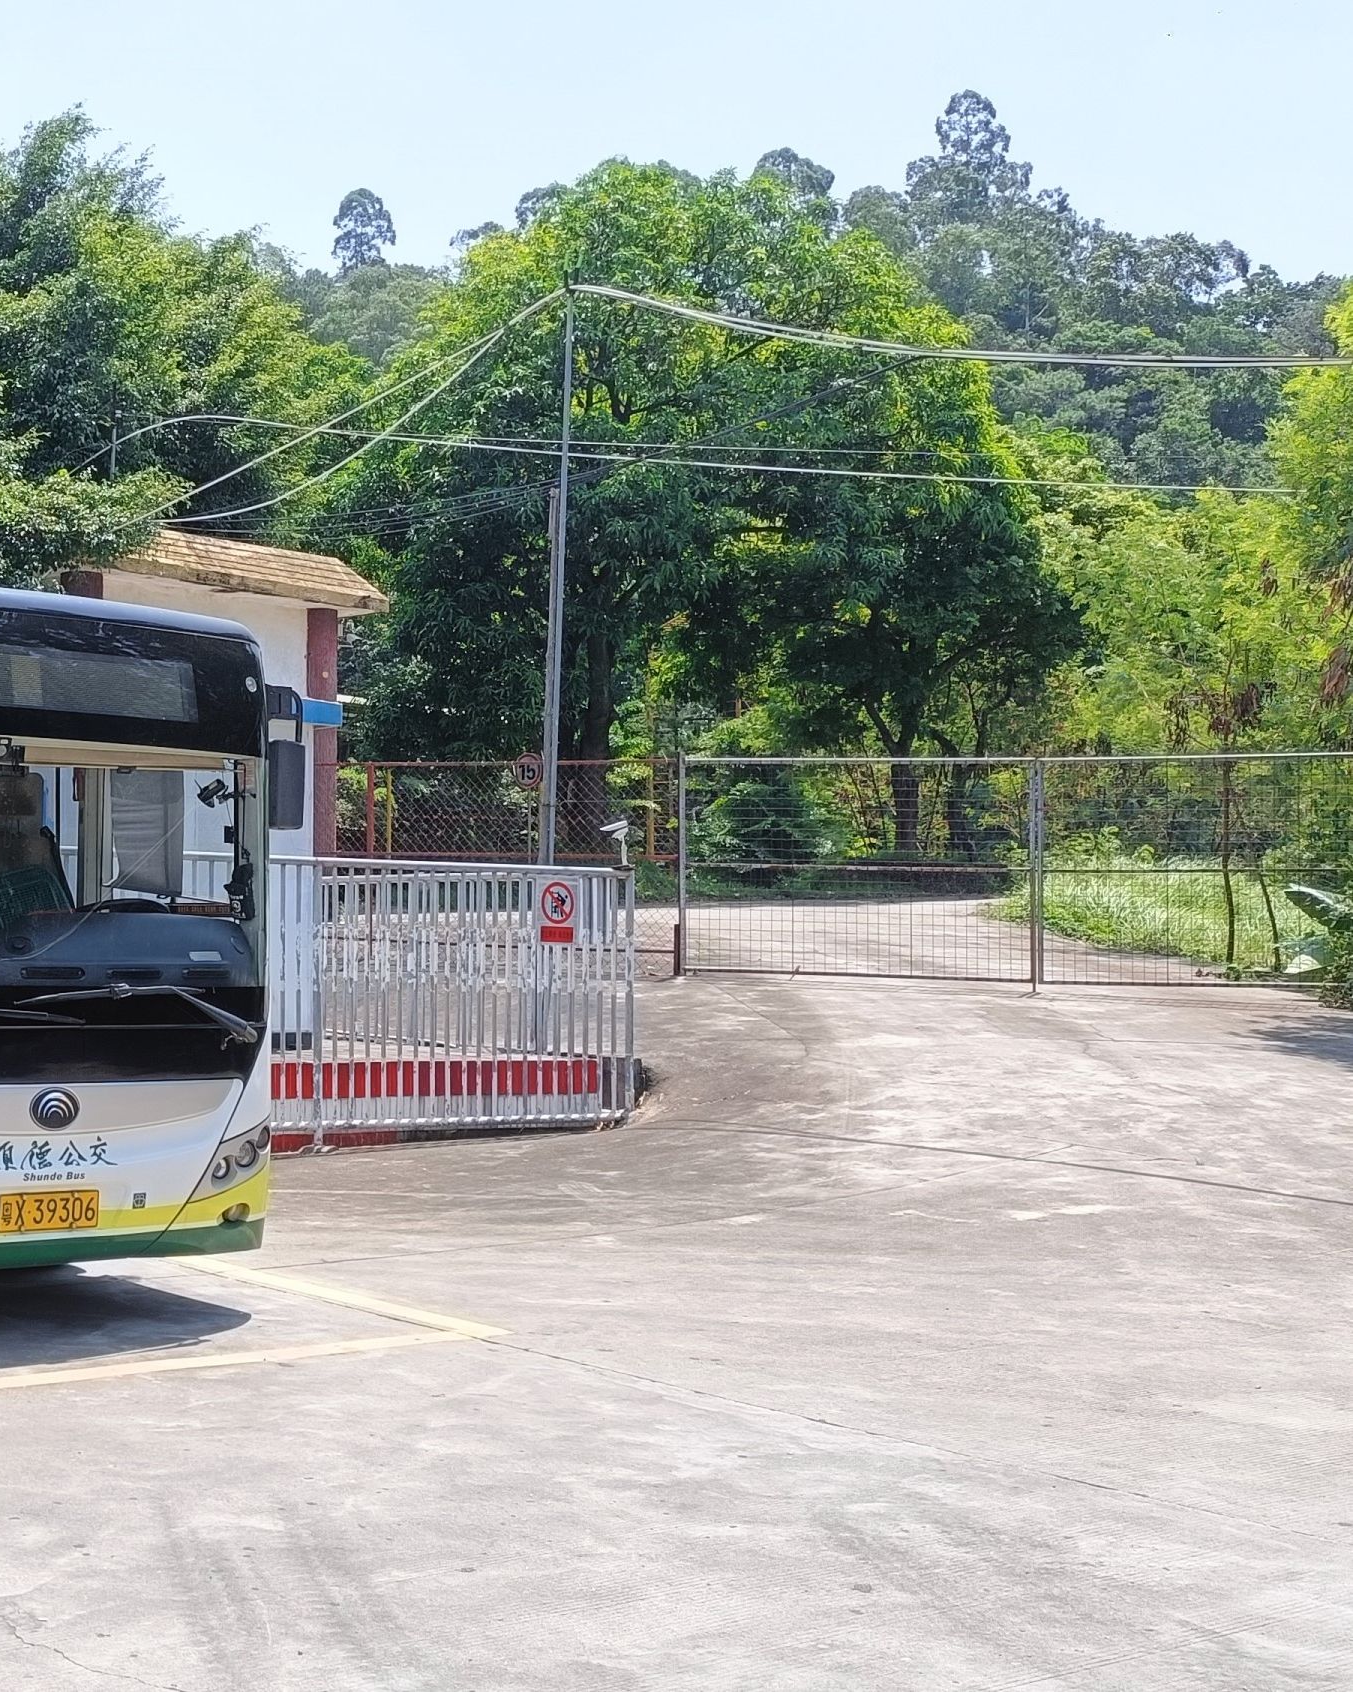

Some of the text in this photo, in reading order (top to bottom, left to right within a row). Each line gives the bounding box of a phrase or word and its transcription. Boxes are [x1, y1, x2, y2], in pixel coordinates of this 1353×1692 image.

[519, 764, 536, 780] 15
[23, 1171, 86, 1182] Shunde Bus
